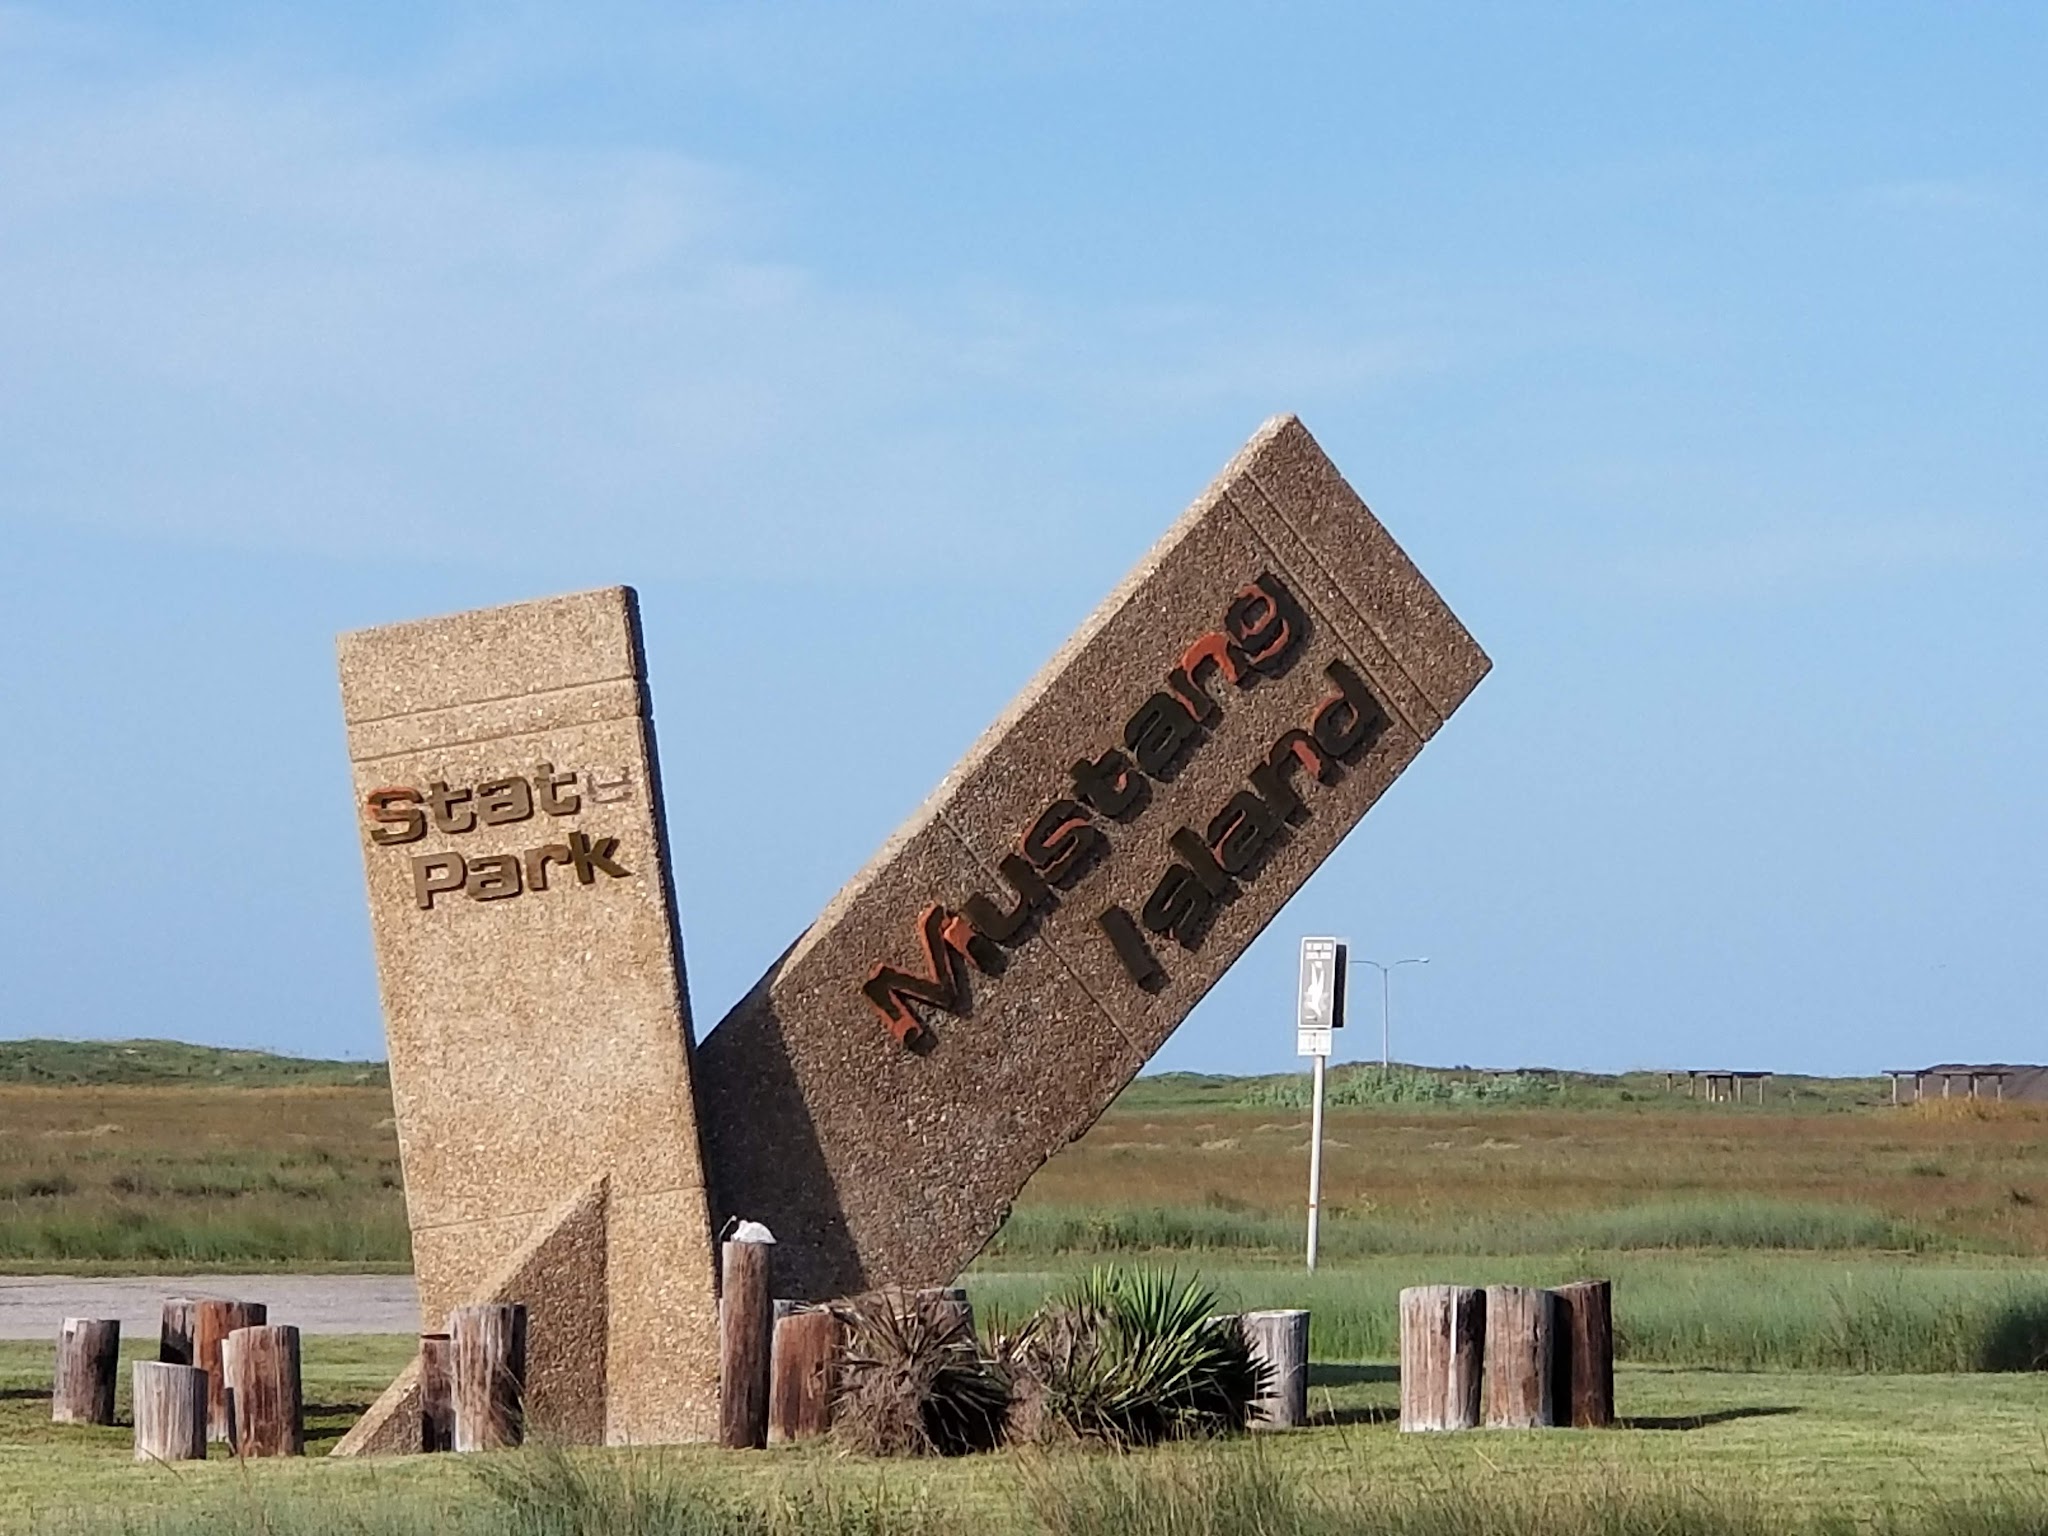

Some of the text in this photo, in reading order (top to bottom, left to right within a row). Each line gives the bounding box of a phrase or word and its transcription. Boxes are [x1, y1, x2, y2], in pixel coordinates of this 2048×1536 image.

[366, 761, 633, 846] Stat
[411, 829, 632, 910] Park
[863, 571, 1308, 1049] Mustang
[1099, 658, 1390, 990] Island
